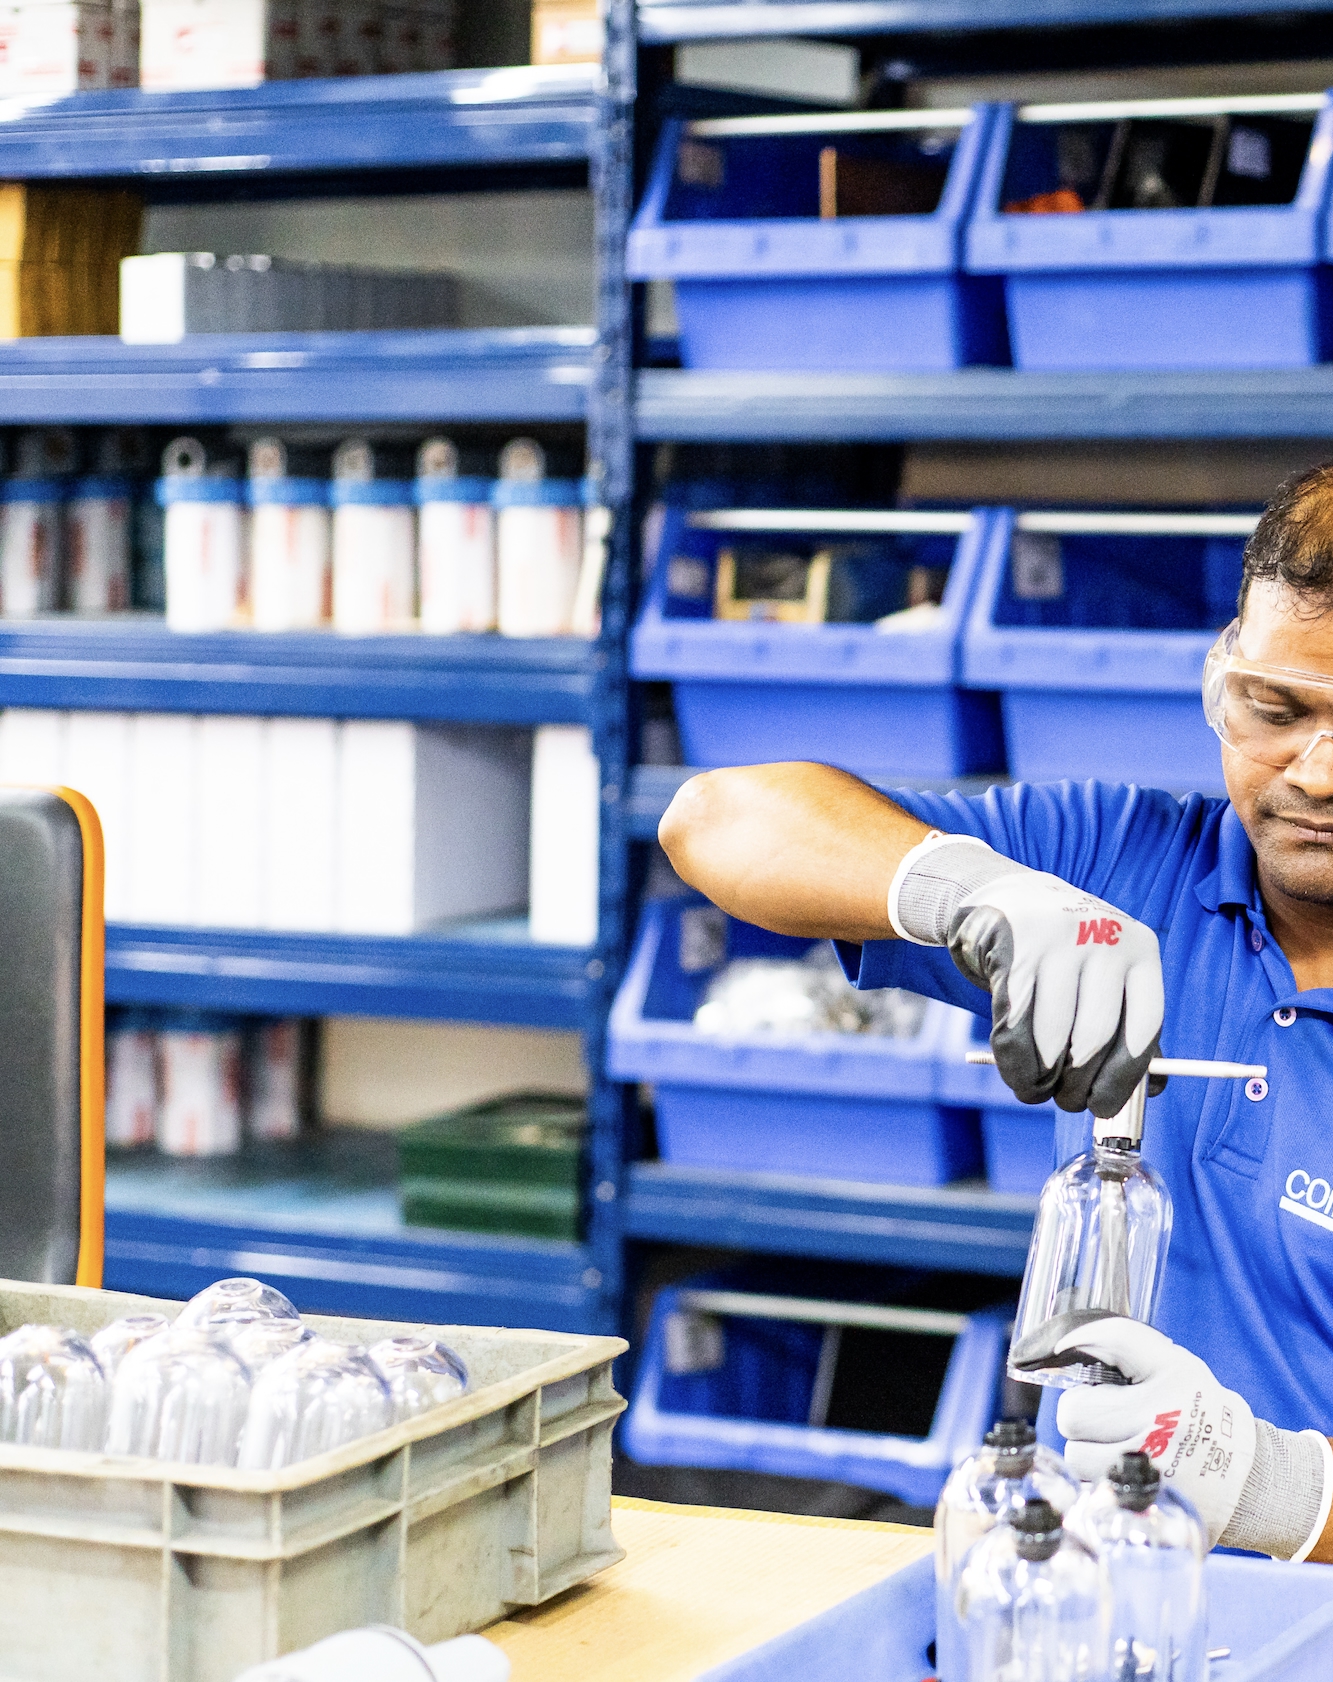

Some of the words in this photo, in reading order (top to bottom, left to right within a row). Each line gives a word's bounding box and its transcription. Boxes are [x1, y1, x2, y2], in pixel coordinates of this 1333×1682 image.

[1076, 917, 1122, 946] 3M
[1138, 1409, 1182, 1459] 3M
[1164, 1423, 1195, 1478] Comfort
[1190, 1391, 1202, 1418] Grip
[1186, 1411, 1206, 1457] Gloves
[1201, 1424, 1213, 1444] 10
